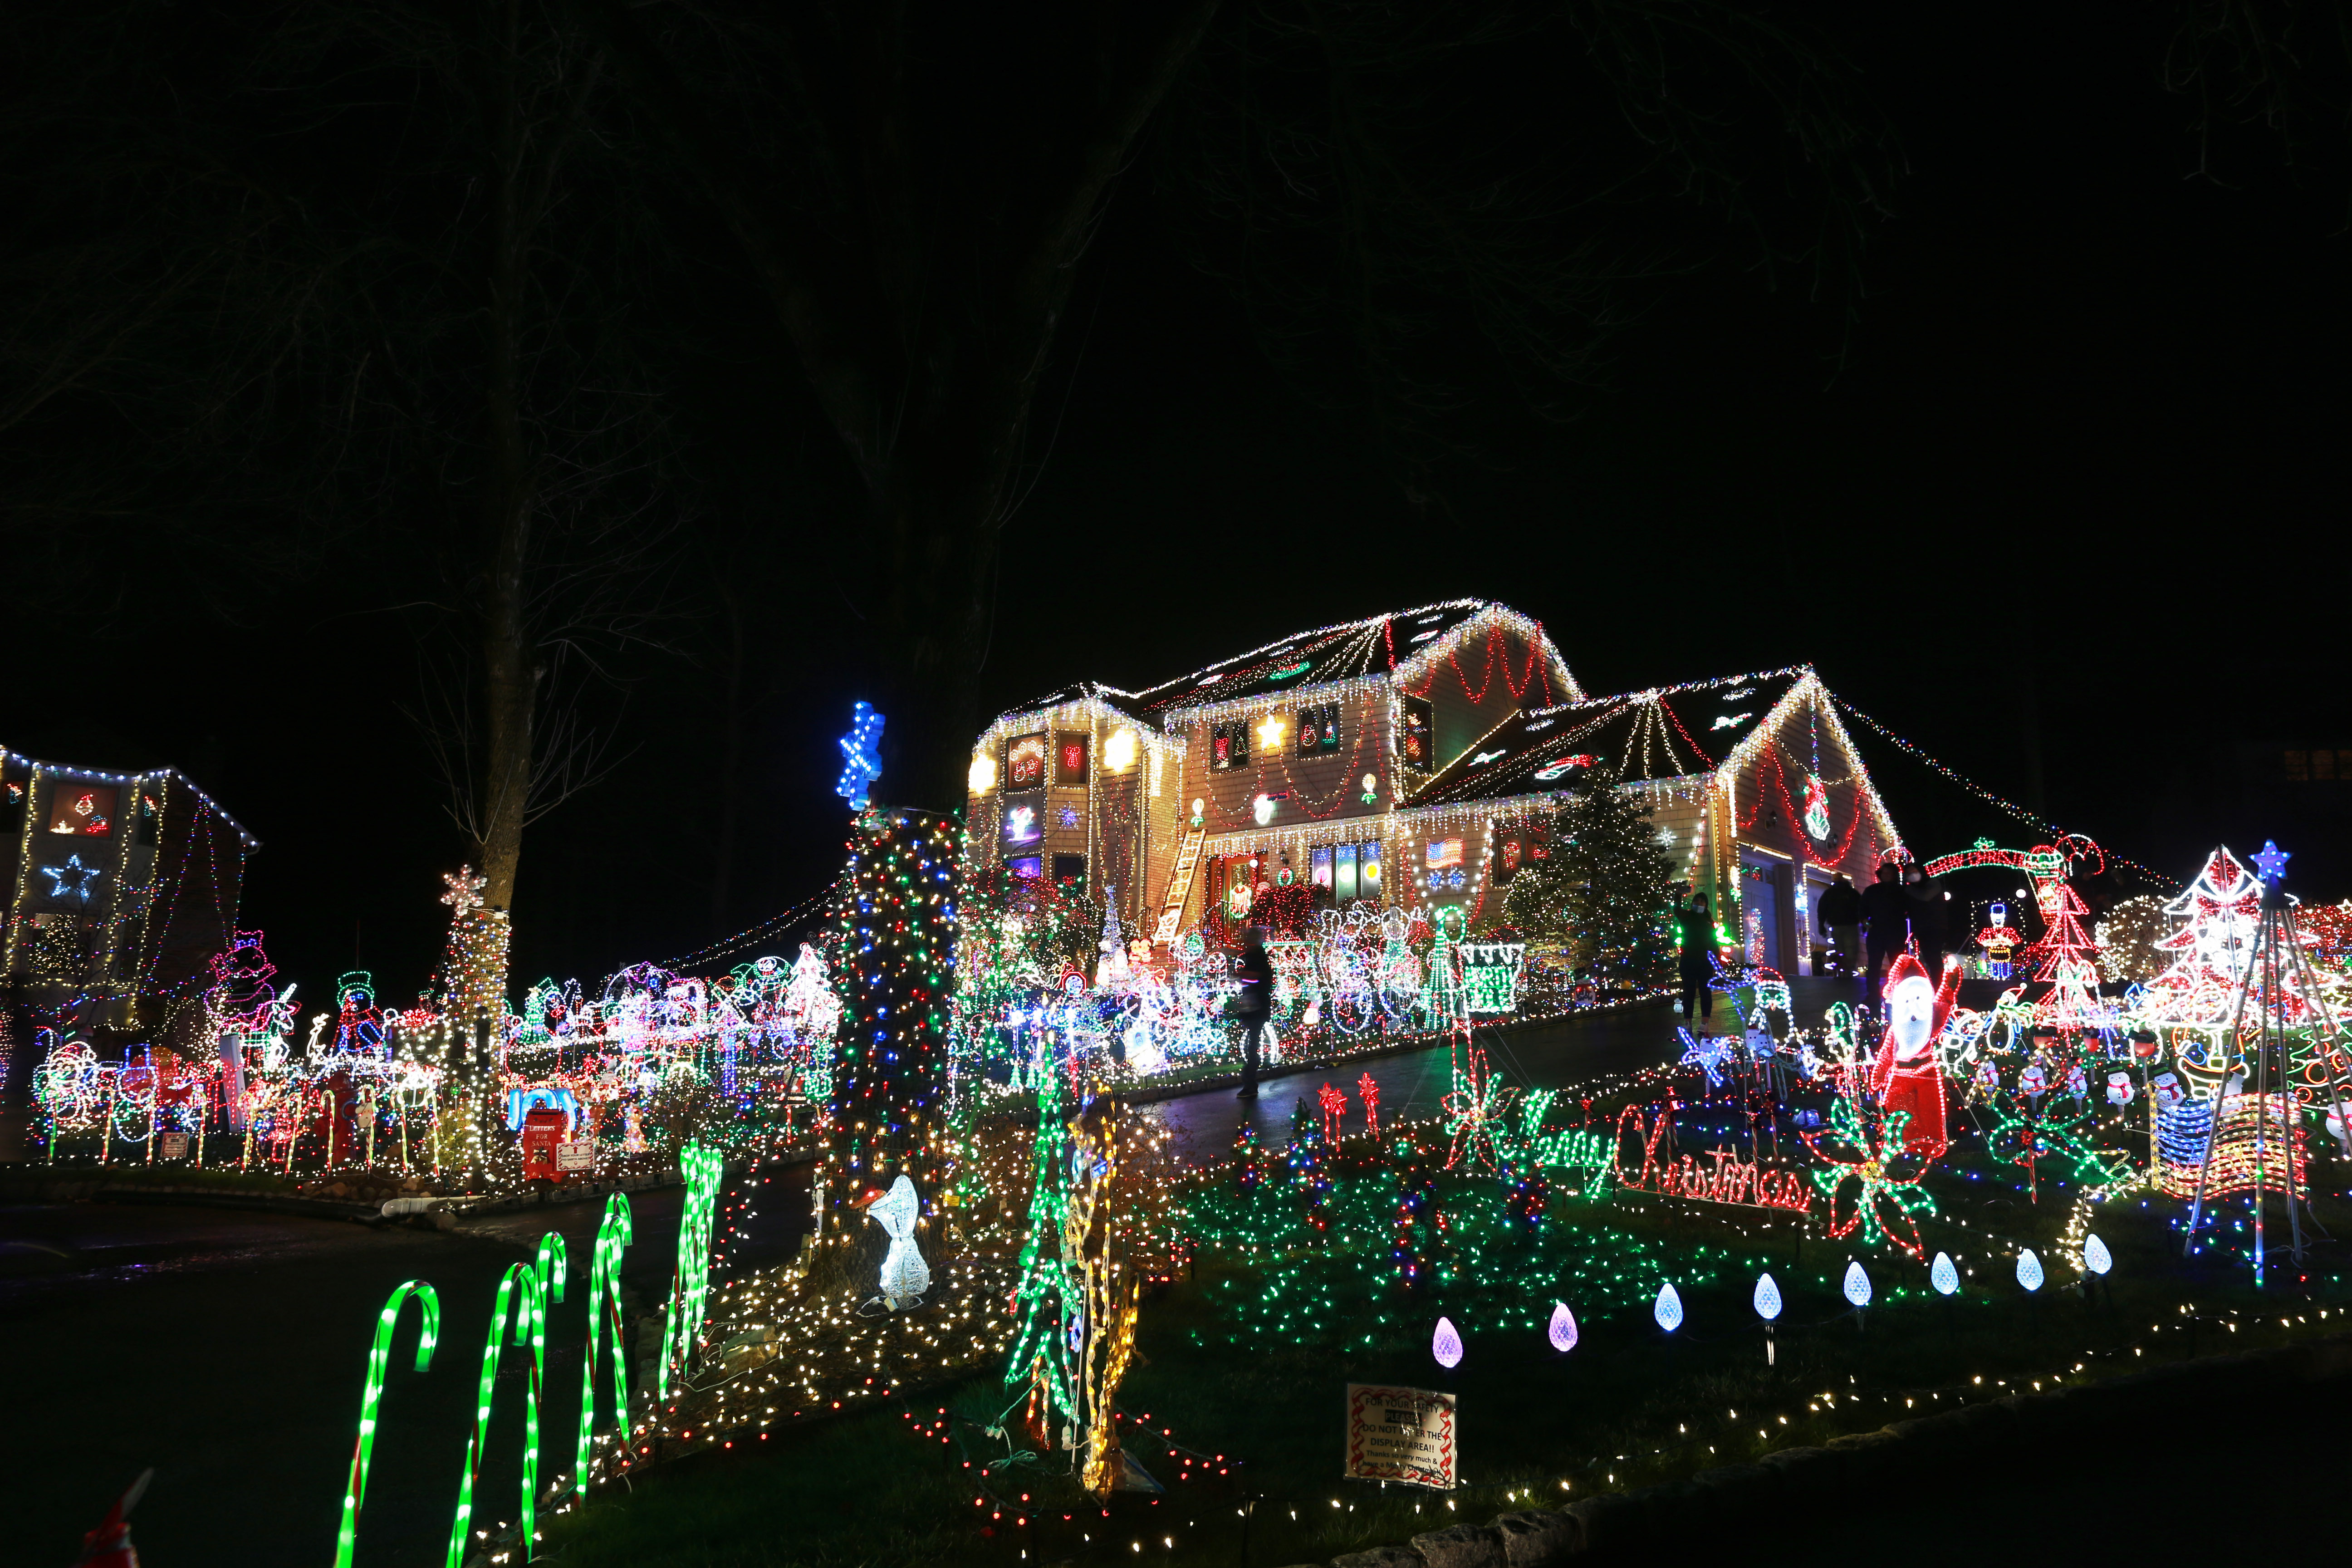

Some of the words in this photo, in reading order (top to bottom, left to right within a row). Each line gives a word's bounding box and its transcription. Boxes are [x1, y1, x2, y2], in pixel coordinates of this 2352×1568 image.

[1366, 1397, 1382, 1406] FOR
[1385, 1399, 1409, 1409] YOUR
[1362, 1424, 1376, 1432] DO
[1378, 1426, 1396, 1434] NOT
[1427, 1431, 1441, 1441] THE
[1370, 1438, 1406, 1448] DISPLAY
[1408, 1442, 1435, 1453] AREA!!
[1386, 1461, 1406, 1471] Merry
